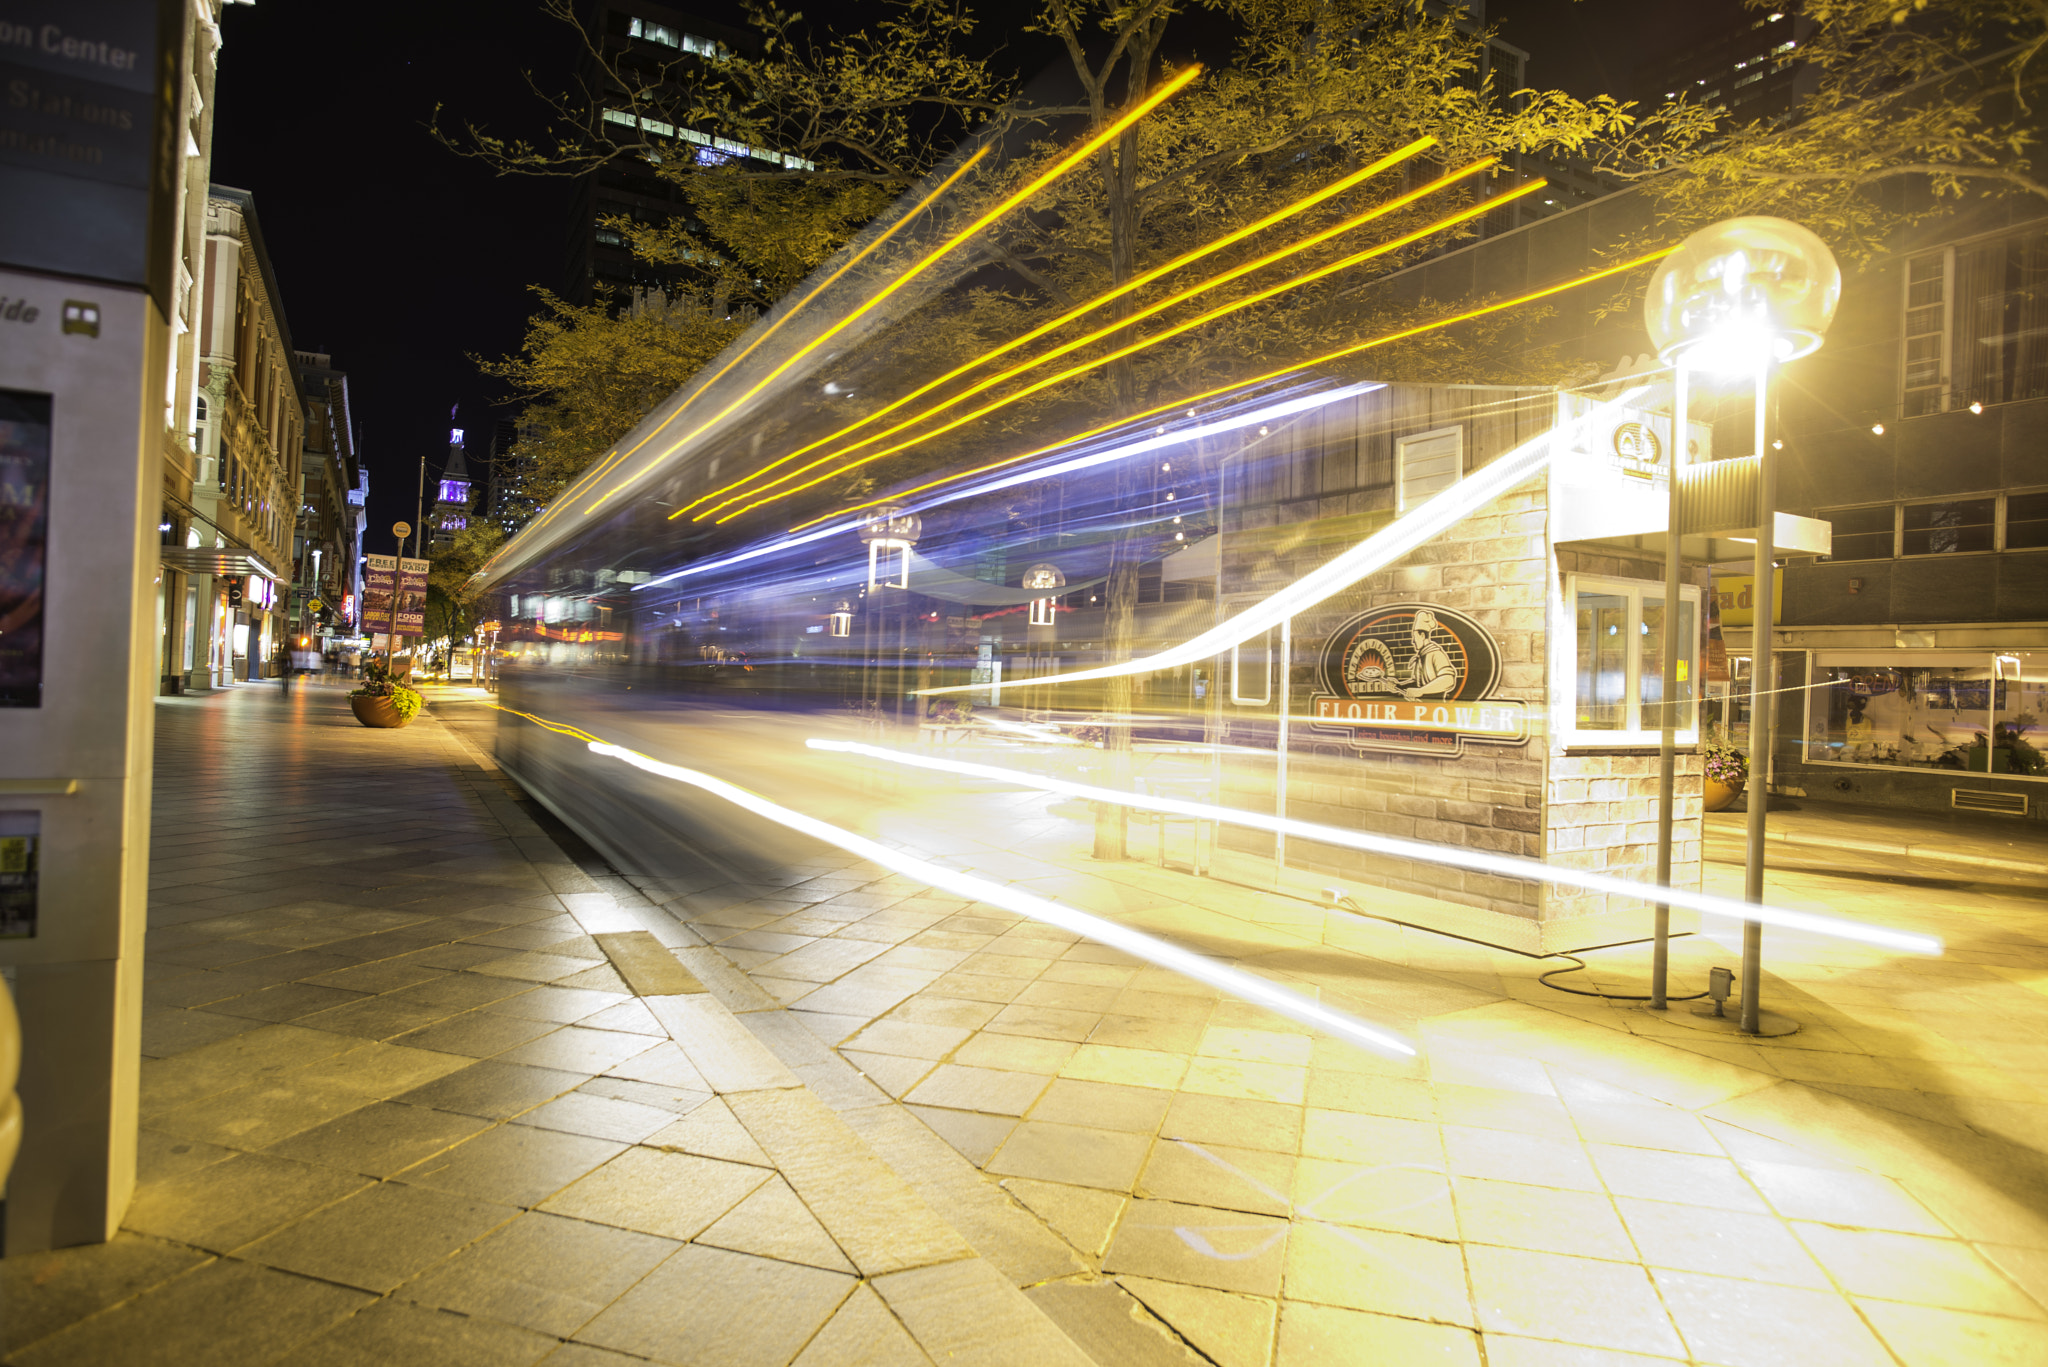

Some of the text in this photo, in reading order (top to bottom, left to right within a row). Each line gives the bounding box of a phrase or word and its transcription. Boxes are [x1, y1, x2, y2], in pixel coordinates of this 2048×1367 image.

[39, 23, 138, 71] Center
[8, 79, 134, 131] Stations
[369, 557, 395, 566] FREE
[402, 564, 427, 573] PARK
[397, 612, 424, 620] FOOD
[1848, 674, 1898, 692] OPEN
[1319, 701, 1516, 732] FLOUR POWER
[1412, 733, 1429, 744] and
[1431, 735, 1454, 746] more
